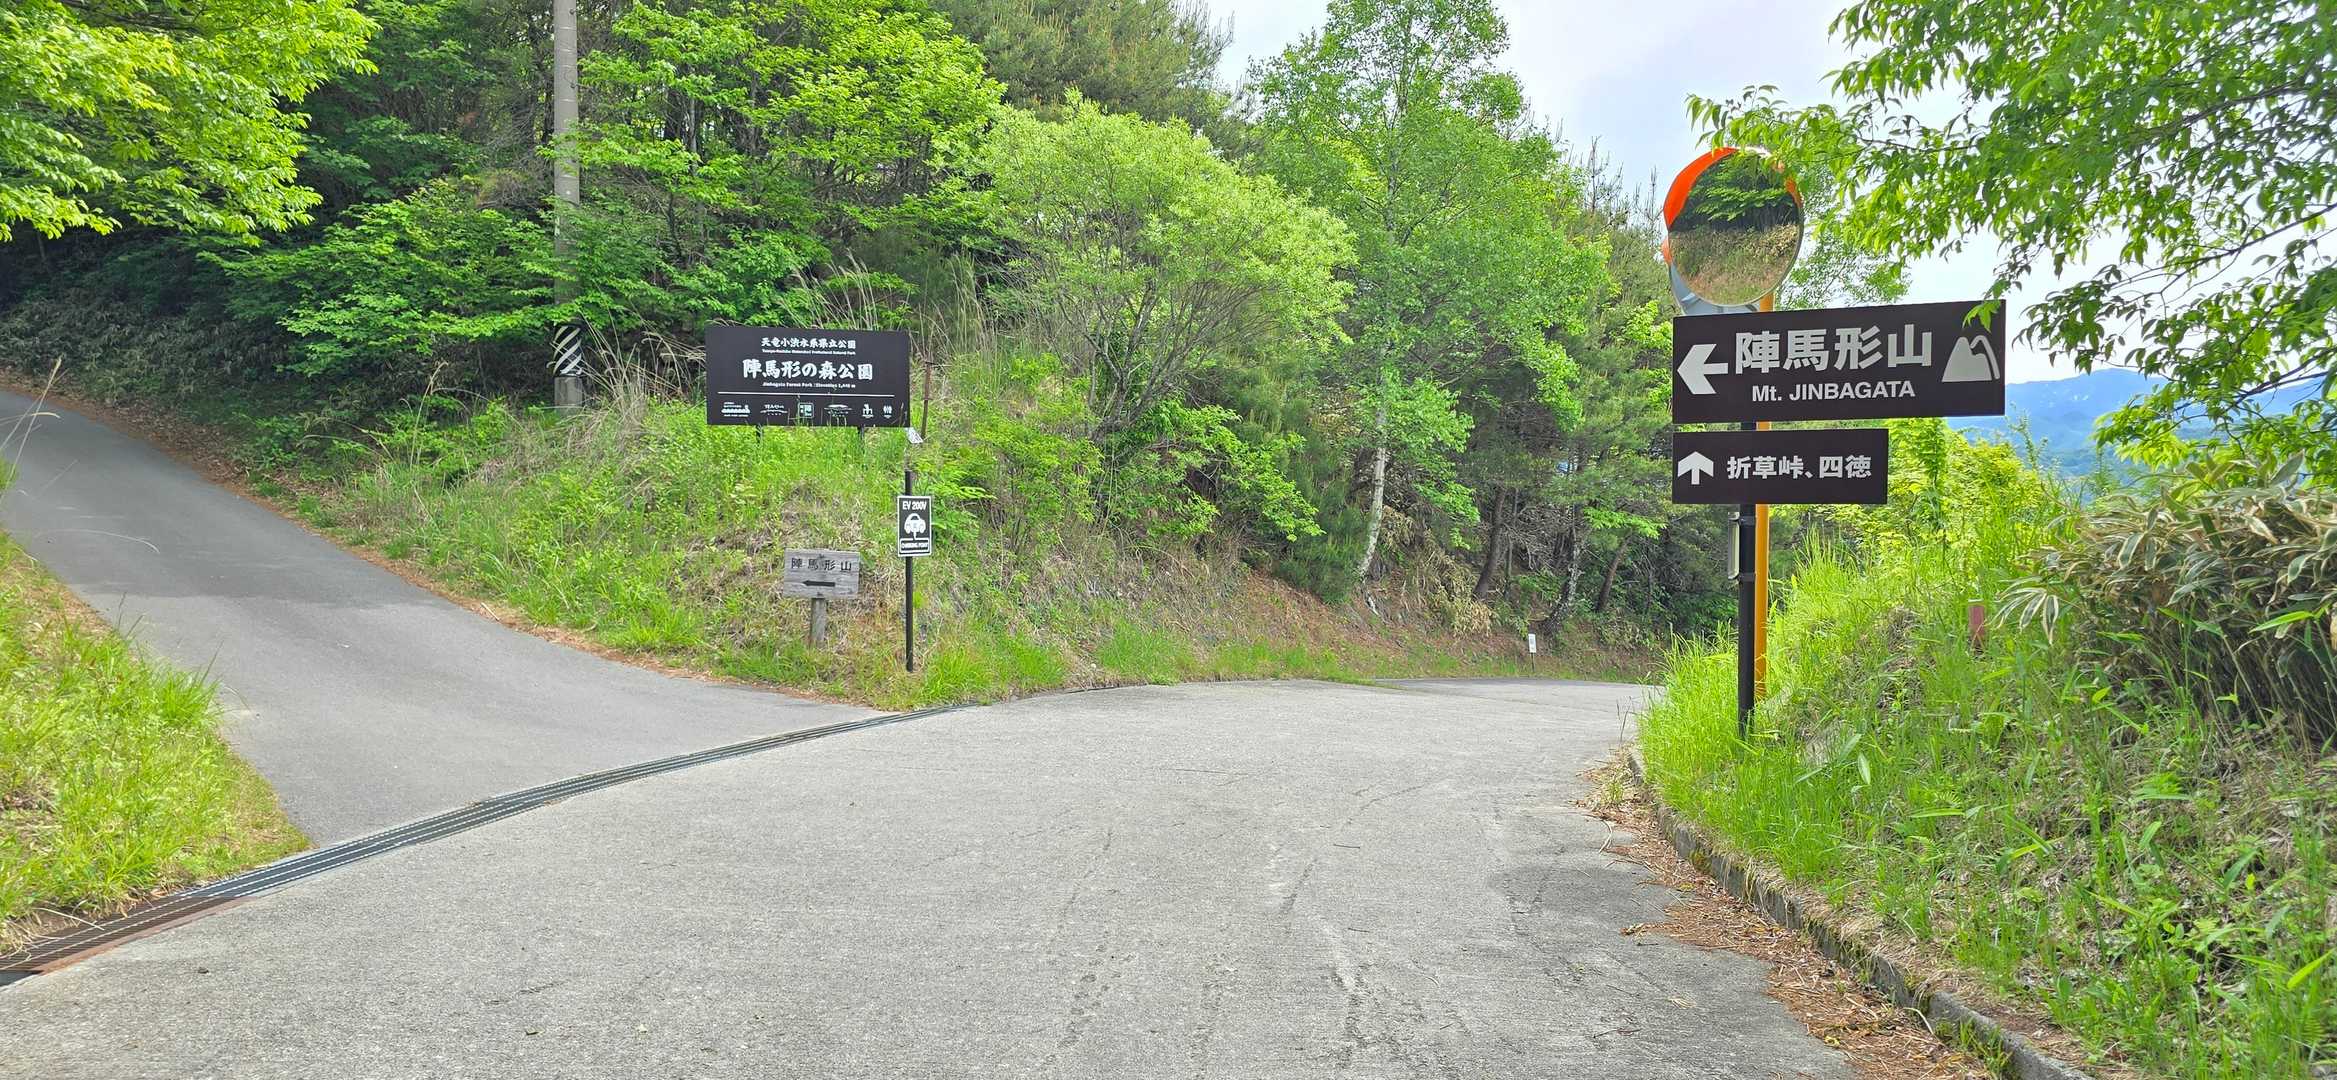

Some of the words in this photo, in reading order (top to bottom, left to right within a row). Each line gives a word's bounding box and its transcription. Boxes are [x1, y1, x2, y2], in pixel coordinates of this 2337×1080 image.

[1735, 324, 1932, 374] 陣馬形山
[742, 359, 873, 381] 陣馬形の森公園
[1752, 385, 1782, 402] Mt.
[1789, 380, 1916, 401] JINBAGATA
[1727, 455, 1872, 479] 折草峠、四徳
[903, 501, 912, 510] EV
[912, 501, 927, 510] 200V
[792, 558, 852, 571] 陣馬形山
